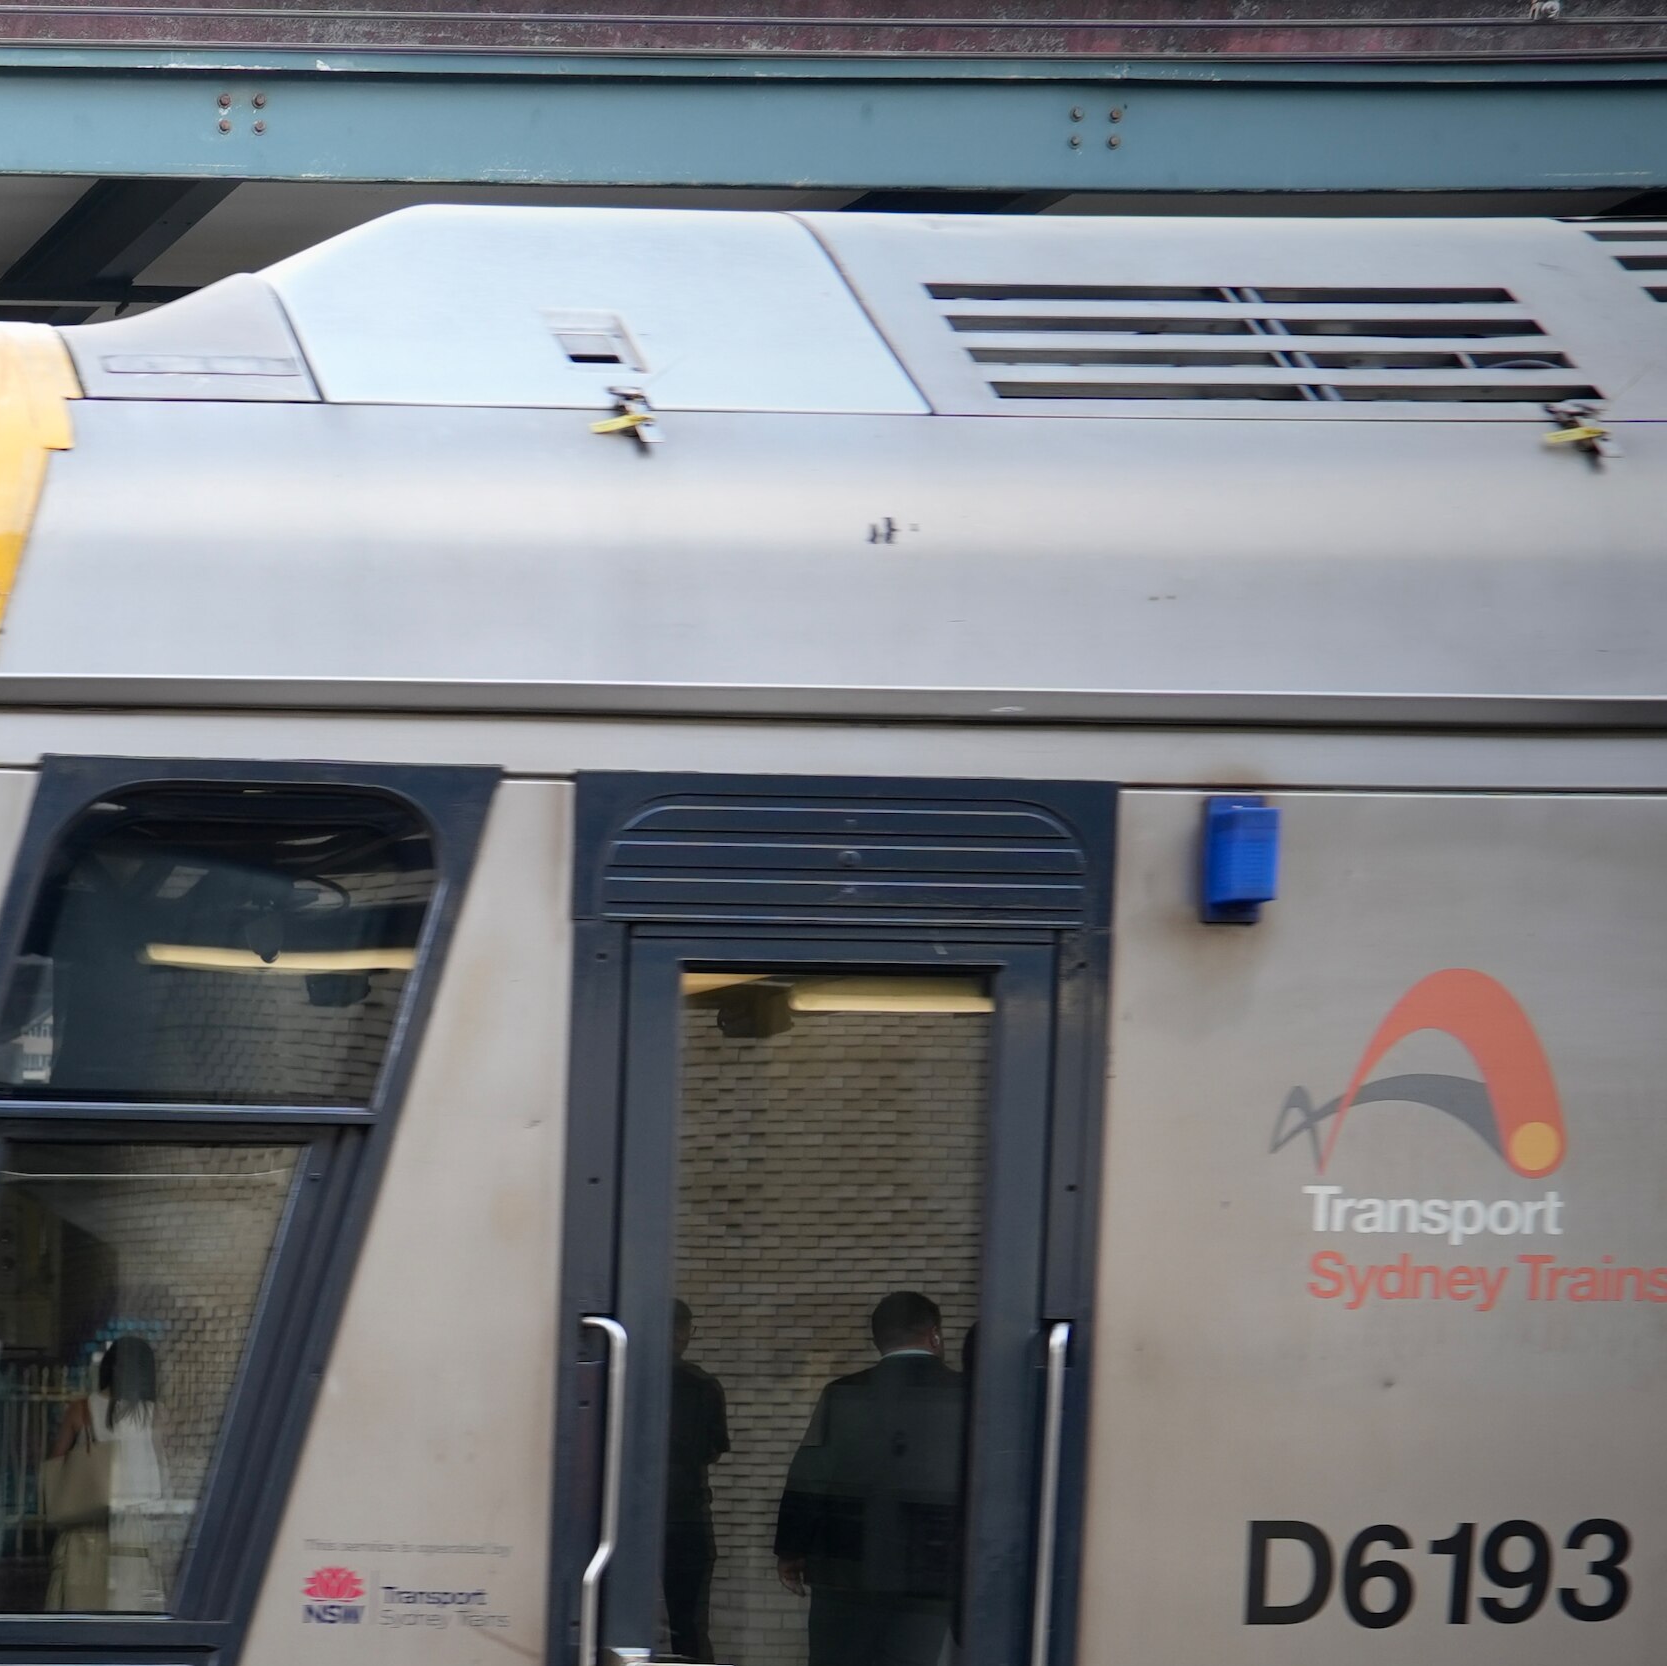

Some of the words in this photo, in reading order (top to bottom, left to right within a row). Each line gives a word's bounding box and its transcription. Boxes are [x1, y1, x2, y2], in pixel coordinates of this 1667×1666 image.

[1304, 1186, 1563, 1245] Transport
[1308, 1250, 1510, 1313] Sydney
[1517, 1255, 1667, 1303] Trains
[1244, 1518, 1633, 1630] D6193
[303, 1605, 365, 1624] NSW
[381, 1586, 487, 1607] Transport
[379, 1609, 451, 1629] Sydney
[453, 1610, 511, 1628] Trains
